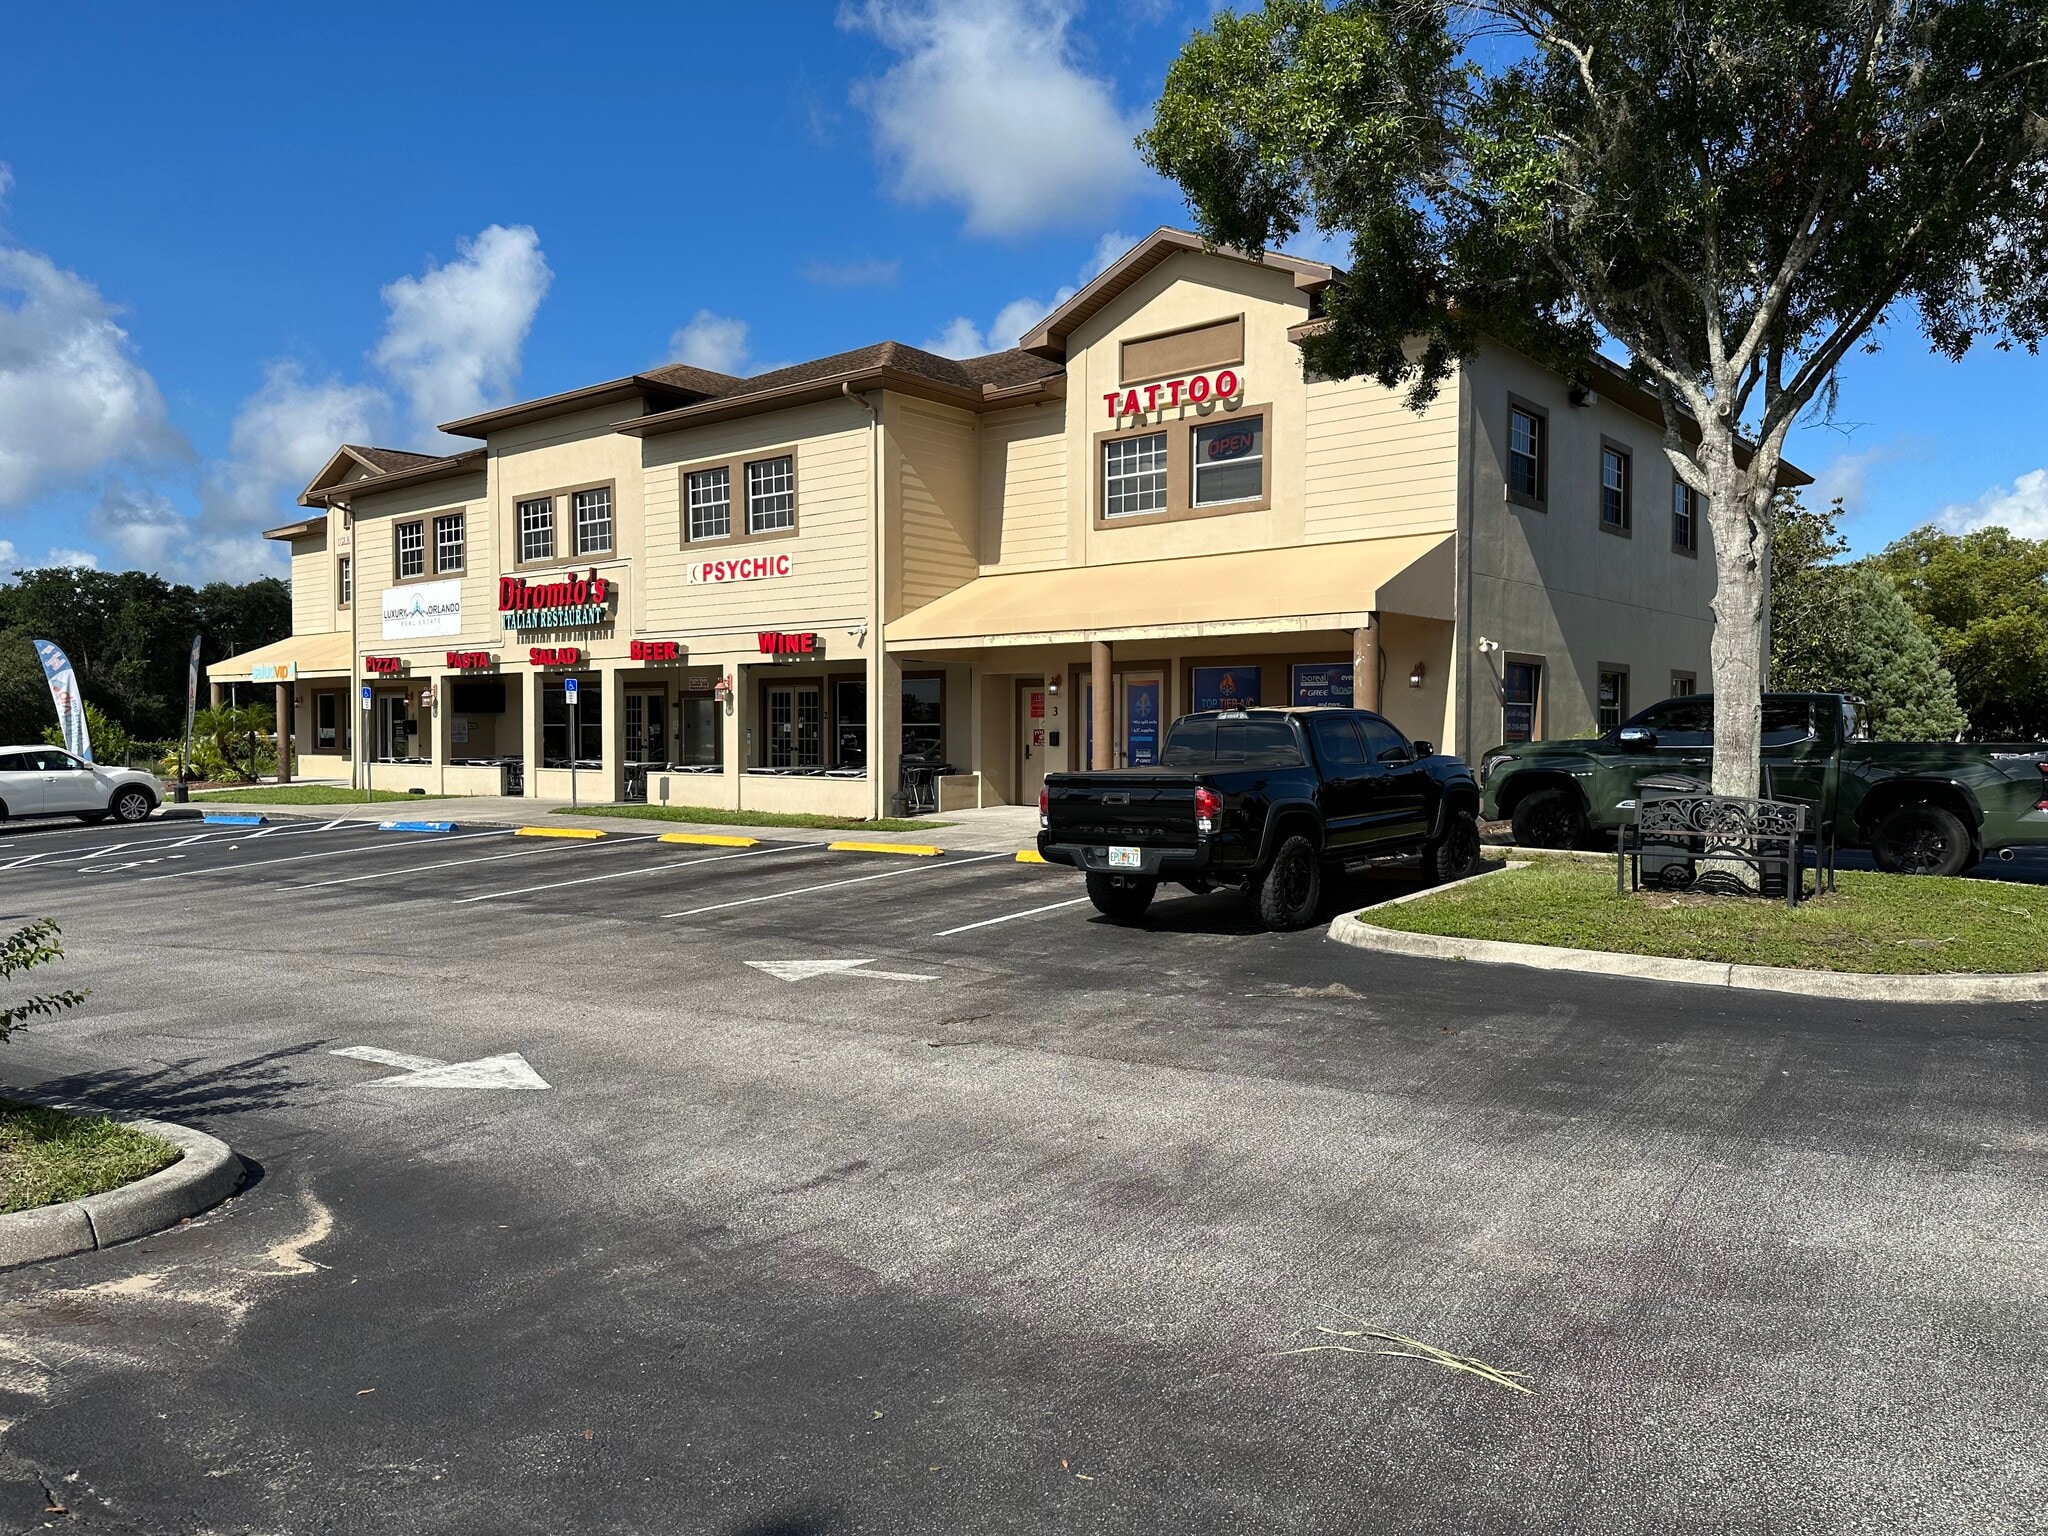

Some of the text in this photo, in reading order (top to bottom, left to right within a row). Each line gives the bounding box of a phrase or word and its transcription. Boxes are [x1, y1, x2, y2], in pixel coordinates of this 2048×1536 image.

[1103, 370, 1239, 418] TATTOO
[1208, 434, 1251, 456] OPEN
[702, 554, 790, 582] PSYCHIC
[498, 567, 607, 611] Diromio's
[384, 603, 460, 619] LUXURY ORLANDO
[503, 607, 602, 630] ITALIAN RESTAURANT
[419, 618, 441, 626] ESTATE
[630, 640, 677, 661] BEER
[757, 632, 813, 654] WINE
[365, 655, 400, 673] PIZZA
[446, 651, 489, 669] PASTA
[529, 647, 578, 666] SALAD
[1301, 673, 1327, 682] boreal
[1307, 689, 1329, 697] GREE
[1052, 706, 1059, 717] 3
[1201, 698, 1218, 709] TOP
[1219, 698, 1238, 709] TIER
[1079, 826, 1165, 836] TACOMA
